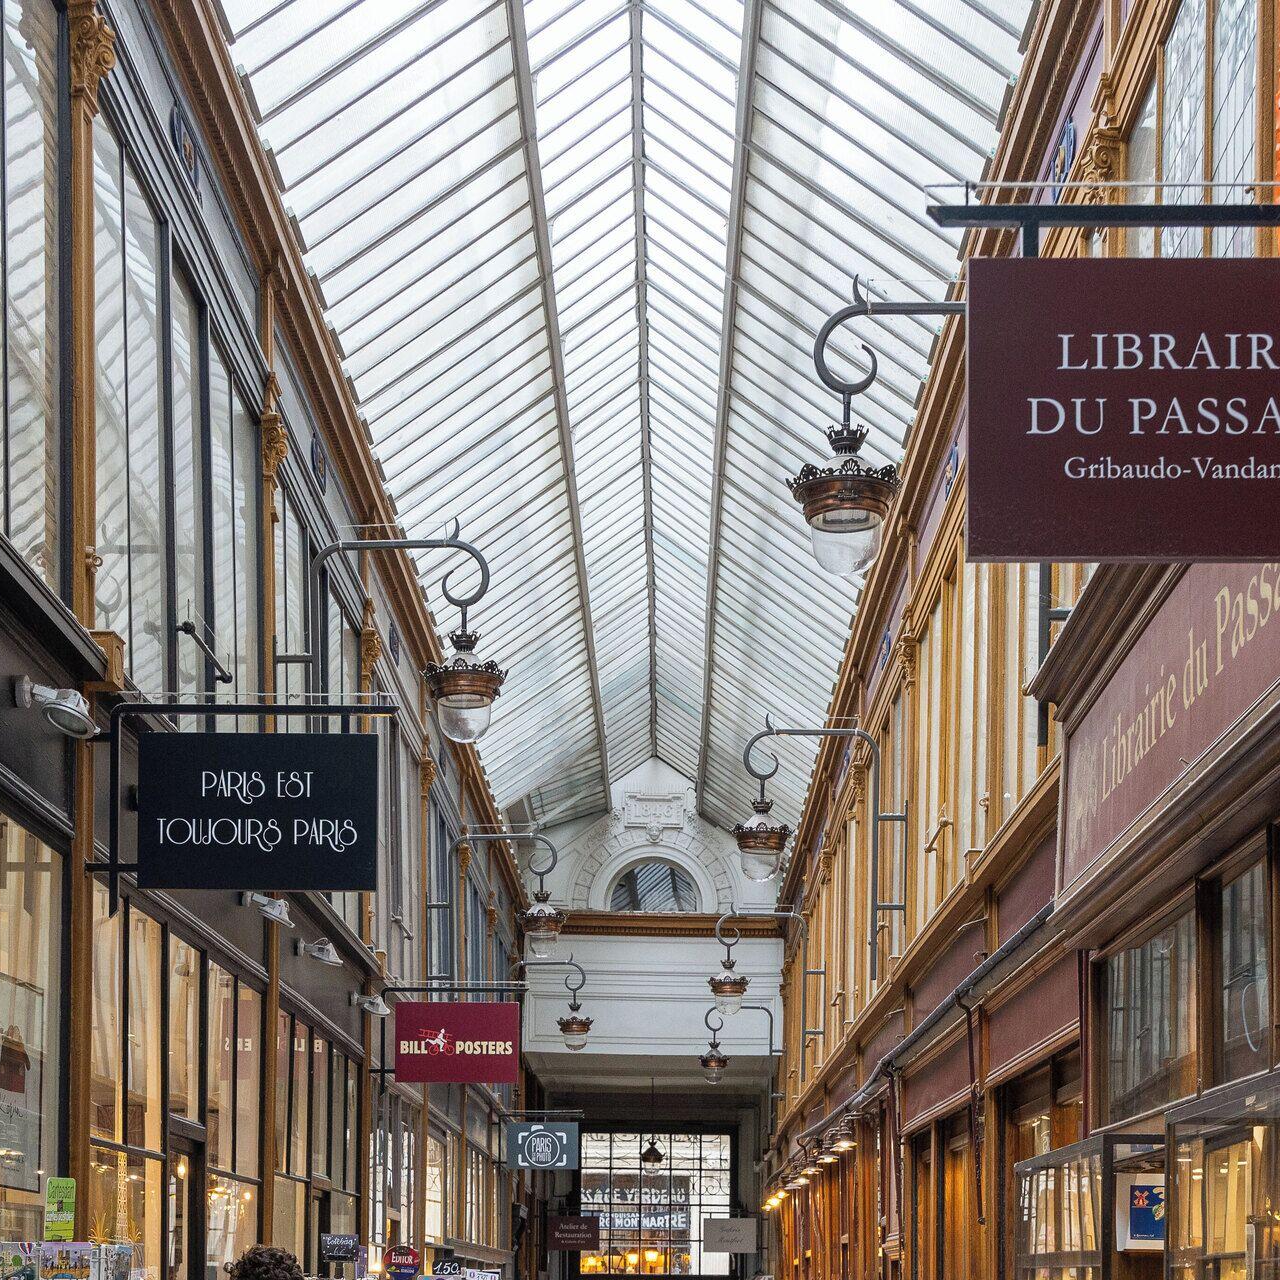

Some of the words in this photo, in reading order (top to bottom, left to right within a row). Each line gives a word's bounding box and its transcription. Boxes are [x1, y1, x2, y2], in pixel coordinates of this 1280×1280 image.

[1026, 397, 1106, 435] DU
[1101, 663, 1177, 803] Librairie
[1182, 626, 1209, 711] du
[201, 770, 266, 805] PARIS
[276, 771, 313, 798] EST
[158, 817, 283, 853] TOUJOURS
[293, 818, 358, 853] PARIS
[400, 1039, 429, 1055] BILL
[455, 1039, 513, 1056] POSTERS
[531, 1137, 552, 1153] PARIS
[554, 1231, 592, 1239] Restauration
[391, 1252, 413, 1265] EDITOR
